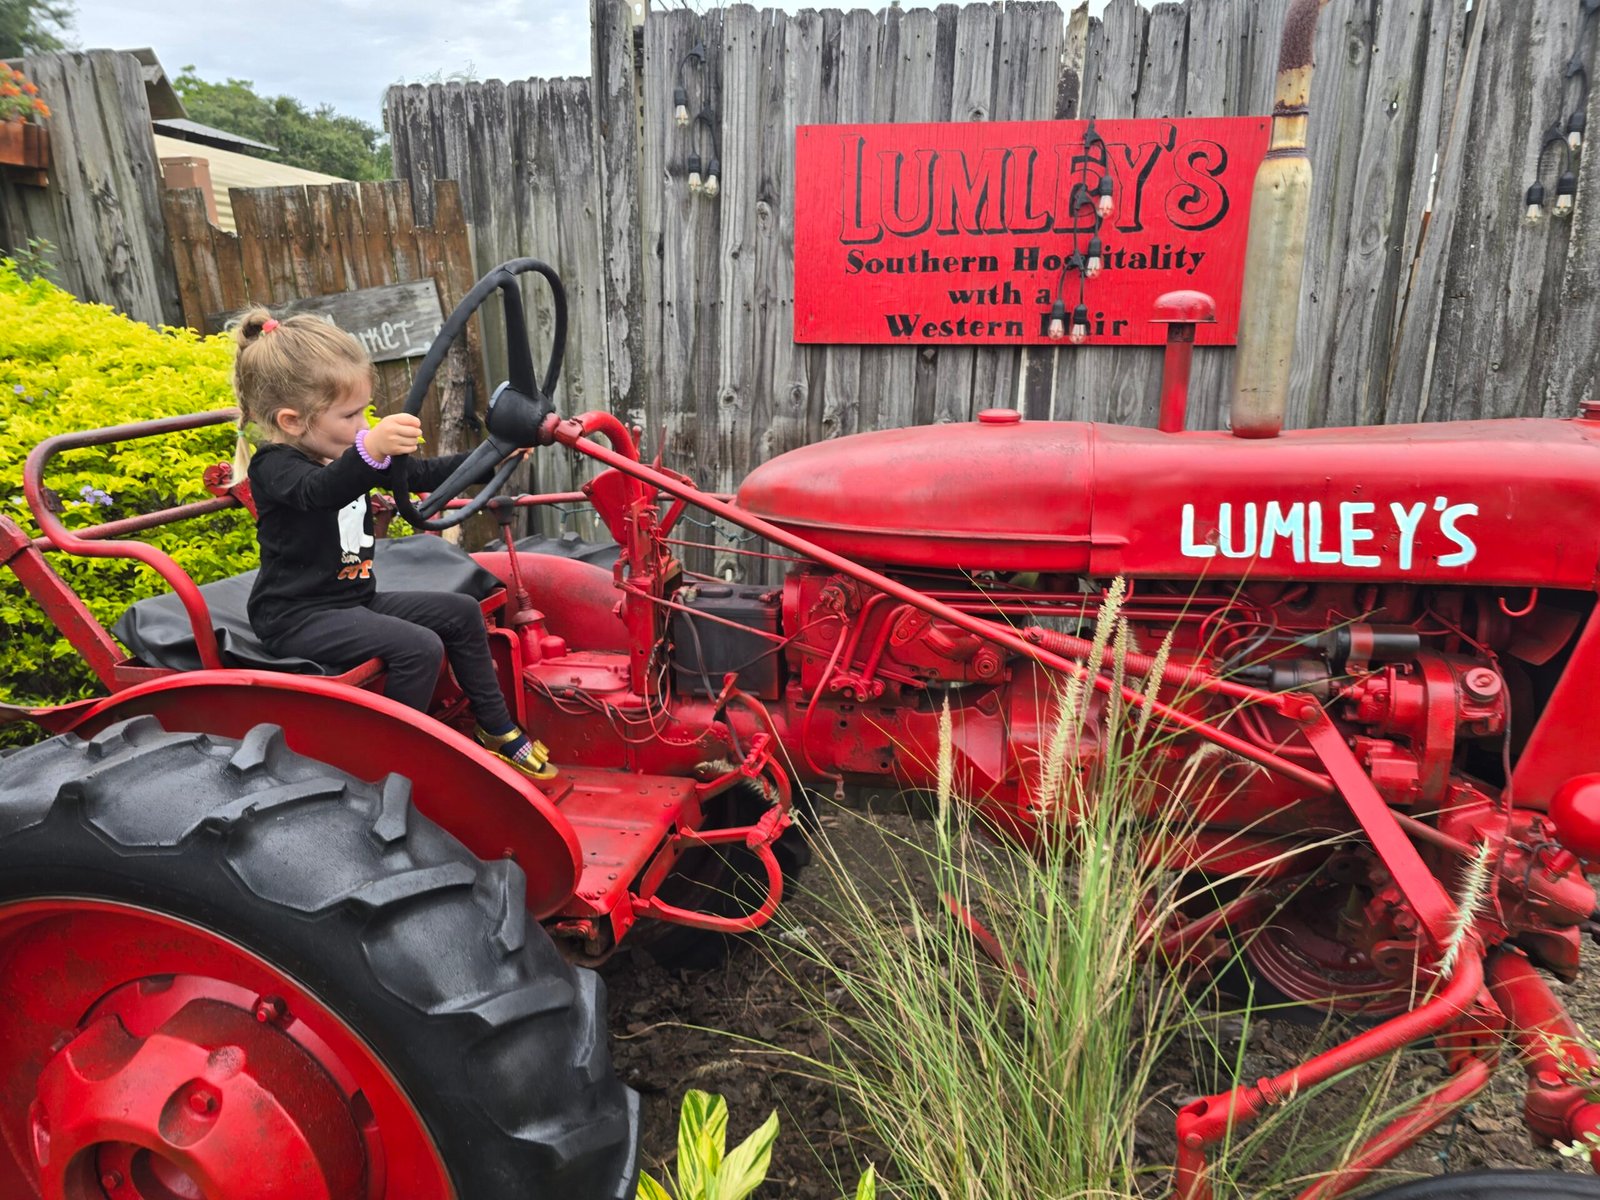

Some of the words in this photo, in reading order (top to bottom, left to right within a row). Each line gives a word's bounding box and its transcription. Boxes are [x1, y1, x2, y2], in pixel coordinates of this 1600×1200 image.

[839, 122, 1230, 245] LUMLEY'S
[845, 248, 999, 275] Southern
[948, 280, 1023, 305] with
[1035, 288, 1052, 305] a
[883, 313, 1024, 338] Western
[1180, 496, 1479, 570] LUMLEY'S
